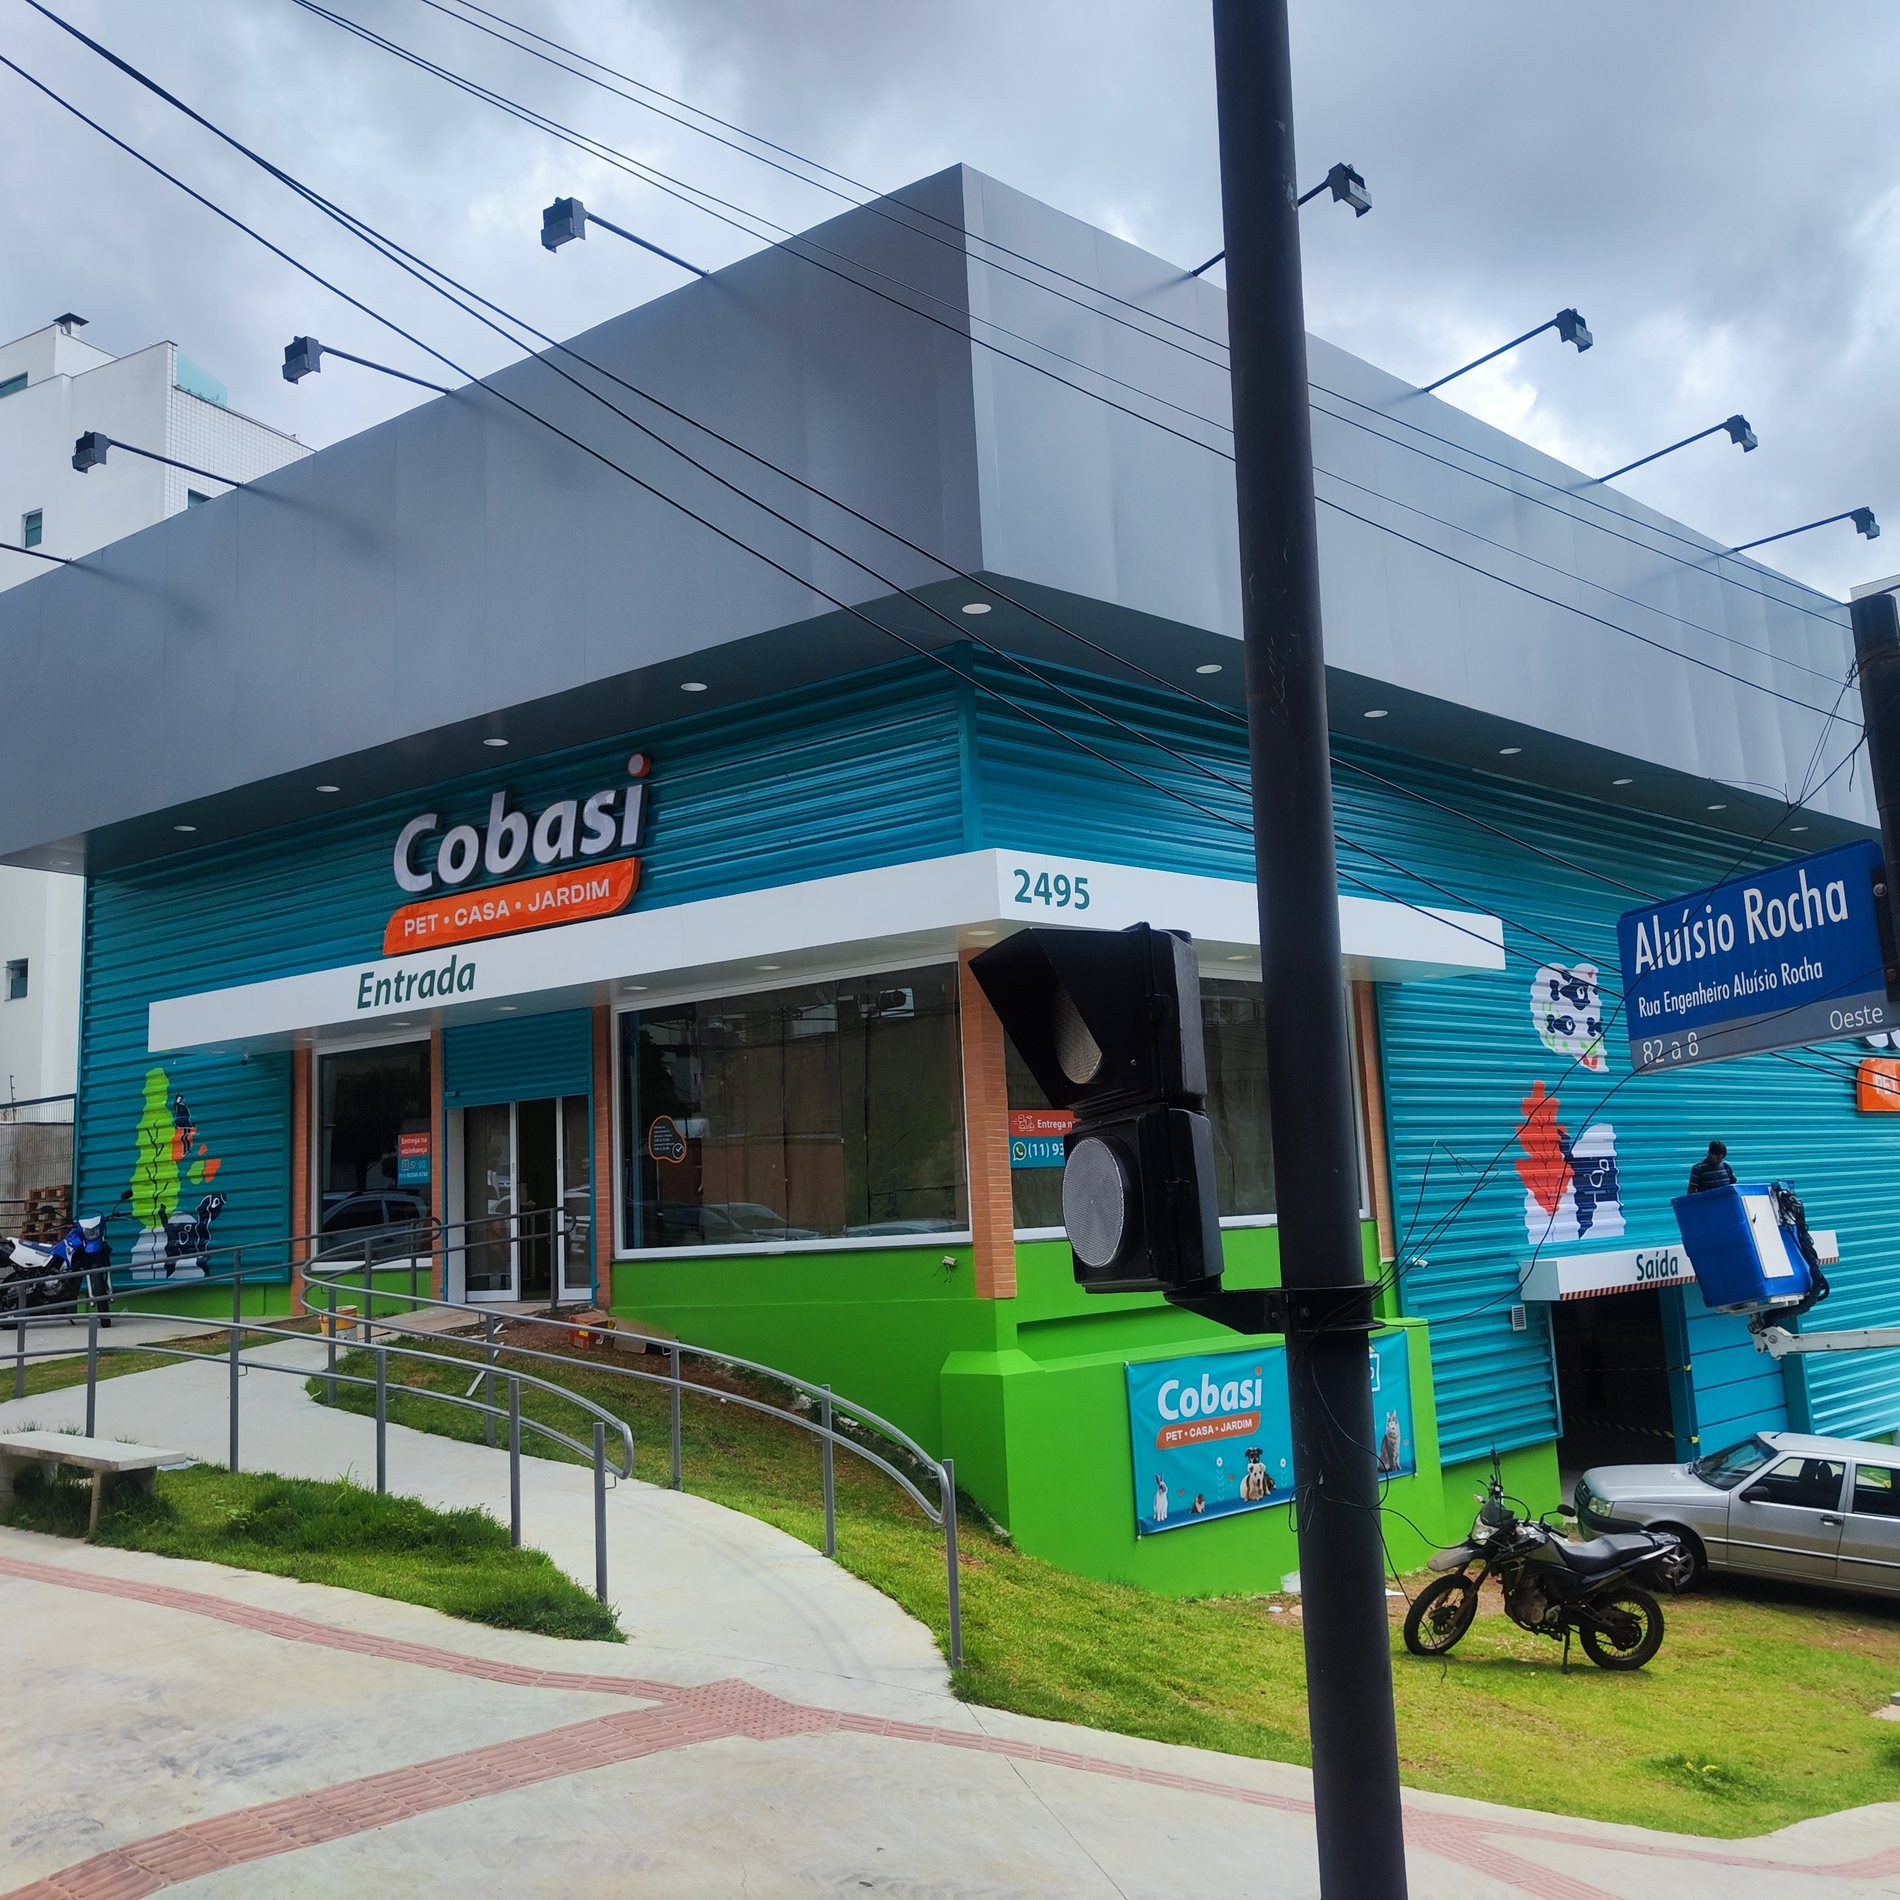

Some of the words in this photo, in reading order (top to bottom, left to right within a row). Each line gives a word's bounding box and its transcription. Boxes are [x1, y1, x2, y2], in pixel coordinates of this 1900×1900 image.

[393, 753, 649, 892] Cobasi
[404, 913, 439, 937] PET
[454, 900, 510, 927] CASA
[528, 878, 610, 912] JARDIM
[1014, 868, 1090, 910] 2495
[1635, 905, 1735, 975] Aluísio
[1743, 869, 1849, 944] Rocha
[357, 954, 476, 1009] Entrada
[1638, 996, 1661, 1018] Rua
[1663, 981, 1730, 1015] Engenheiro
[1733, 968, 1778, 998] Aluísio
[1781, 956, 1823, 986] Rocha
[1830, 1005, 1884, 1031] Oeste
[1642, 1039, 1665, 1065] 82
[1671, 1040, 1682, 1060] a
[1687, 1032, 1699, 1057] 8
[1037, 1119, 1066, 1131] Entrega
[1028, 1142, 1049, 1158] (11)
[1052, 1142, 1065, 1156] 93
[1636, 1249, 1678, 1281] Saída
[1158, 1366, 1262, 1420] Cobasi
[1165, 1429, 1183, 1442] PET
[1189, 1425, 1214, 1437] CASA
[1220, 1418, 1253, 1432] JARDIM
